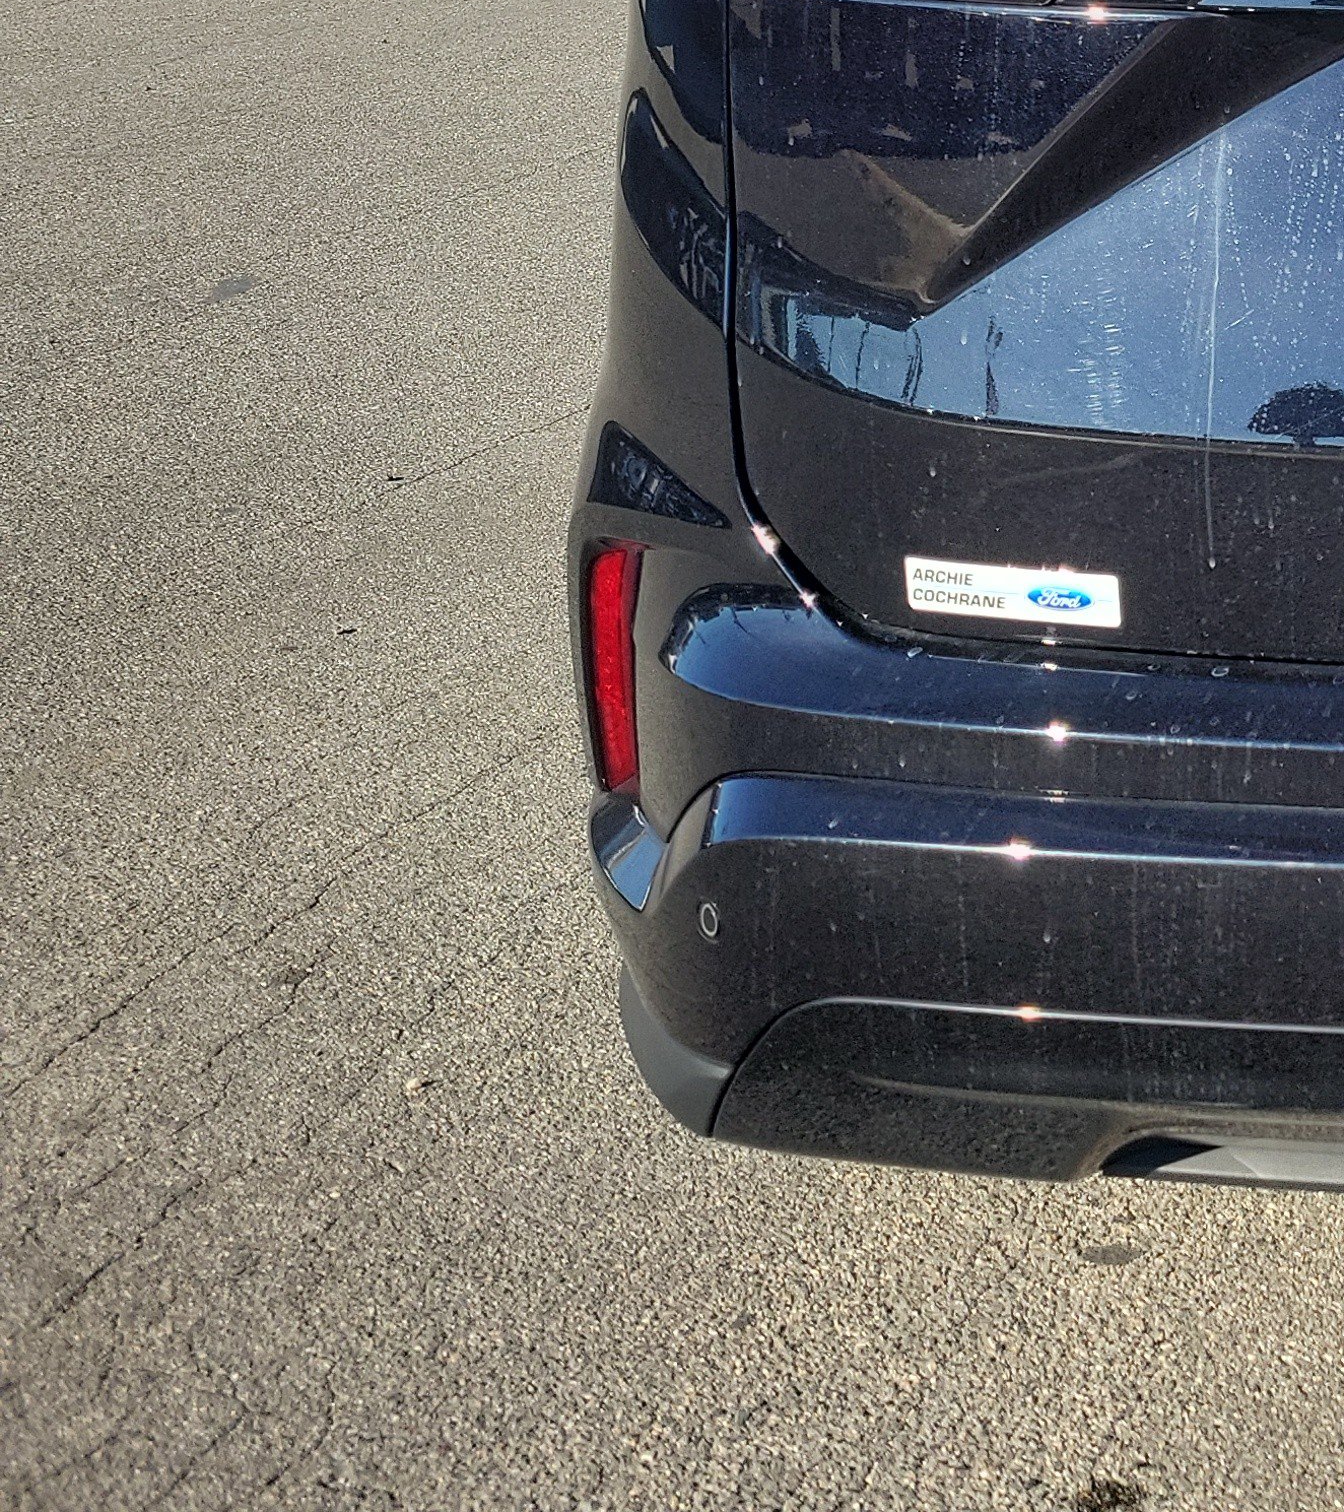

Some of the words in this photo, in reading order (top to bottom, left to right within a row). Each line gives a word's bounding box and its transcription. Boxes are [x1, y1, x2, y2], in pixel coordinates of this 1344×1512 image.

[913, 568, 974, 586] ARCHIE
[913, 588, 1006, 609] COCHRANE
[1036, 589, 1082, 608] Ford
